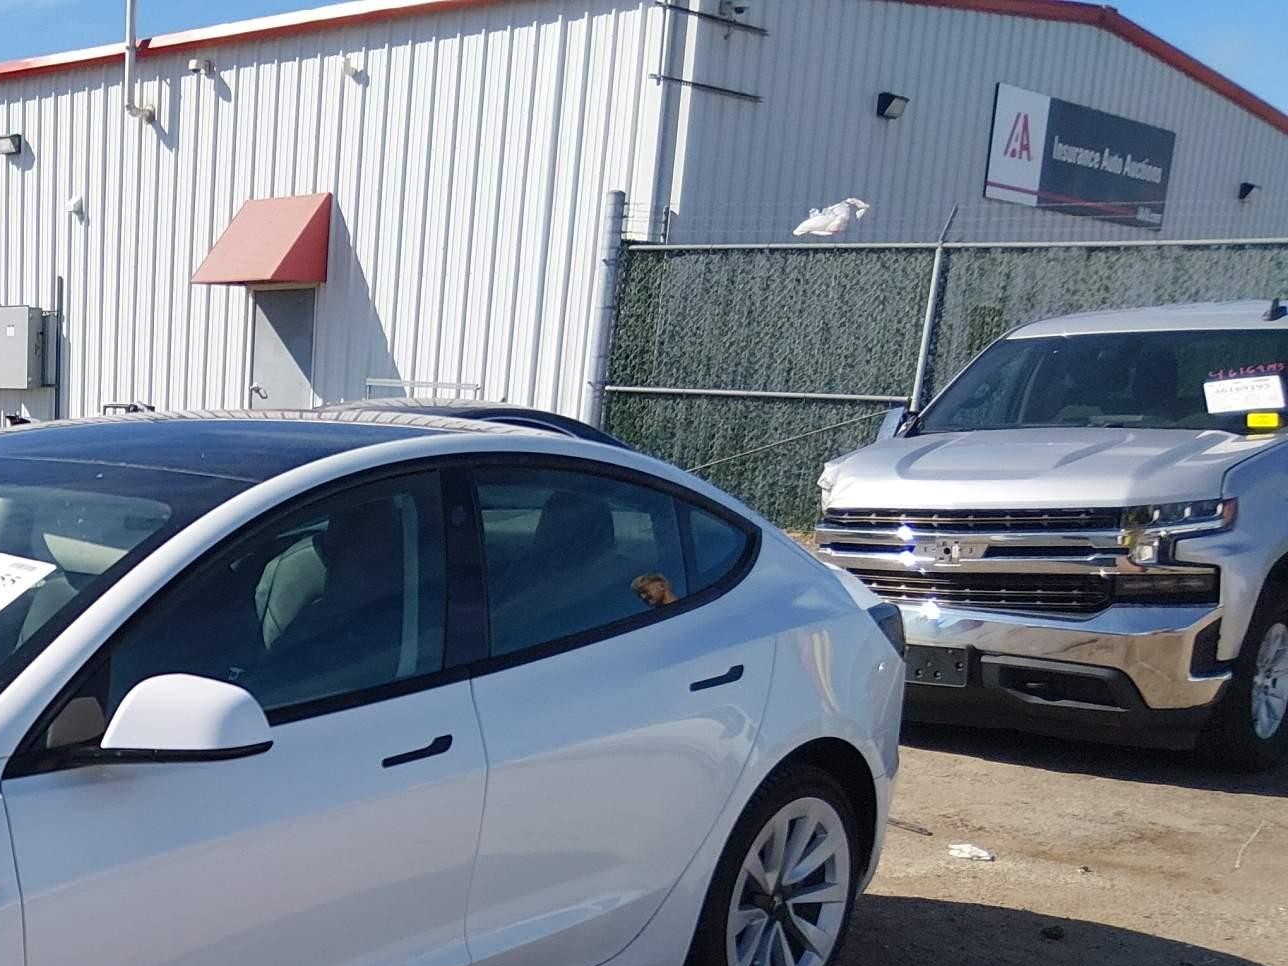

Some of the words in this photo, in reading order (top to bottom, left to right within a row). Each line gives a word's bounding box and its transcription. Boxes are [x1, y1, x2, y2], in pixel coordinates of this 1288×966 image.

[1052, 135, 1101, 169] Insurance
[1100, 147, 1123, 174] Auto
[1122, 153, 1163, 184] Auctions
